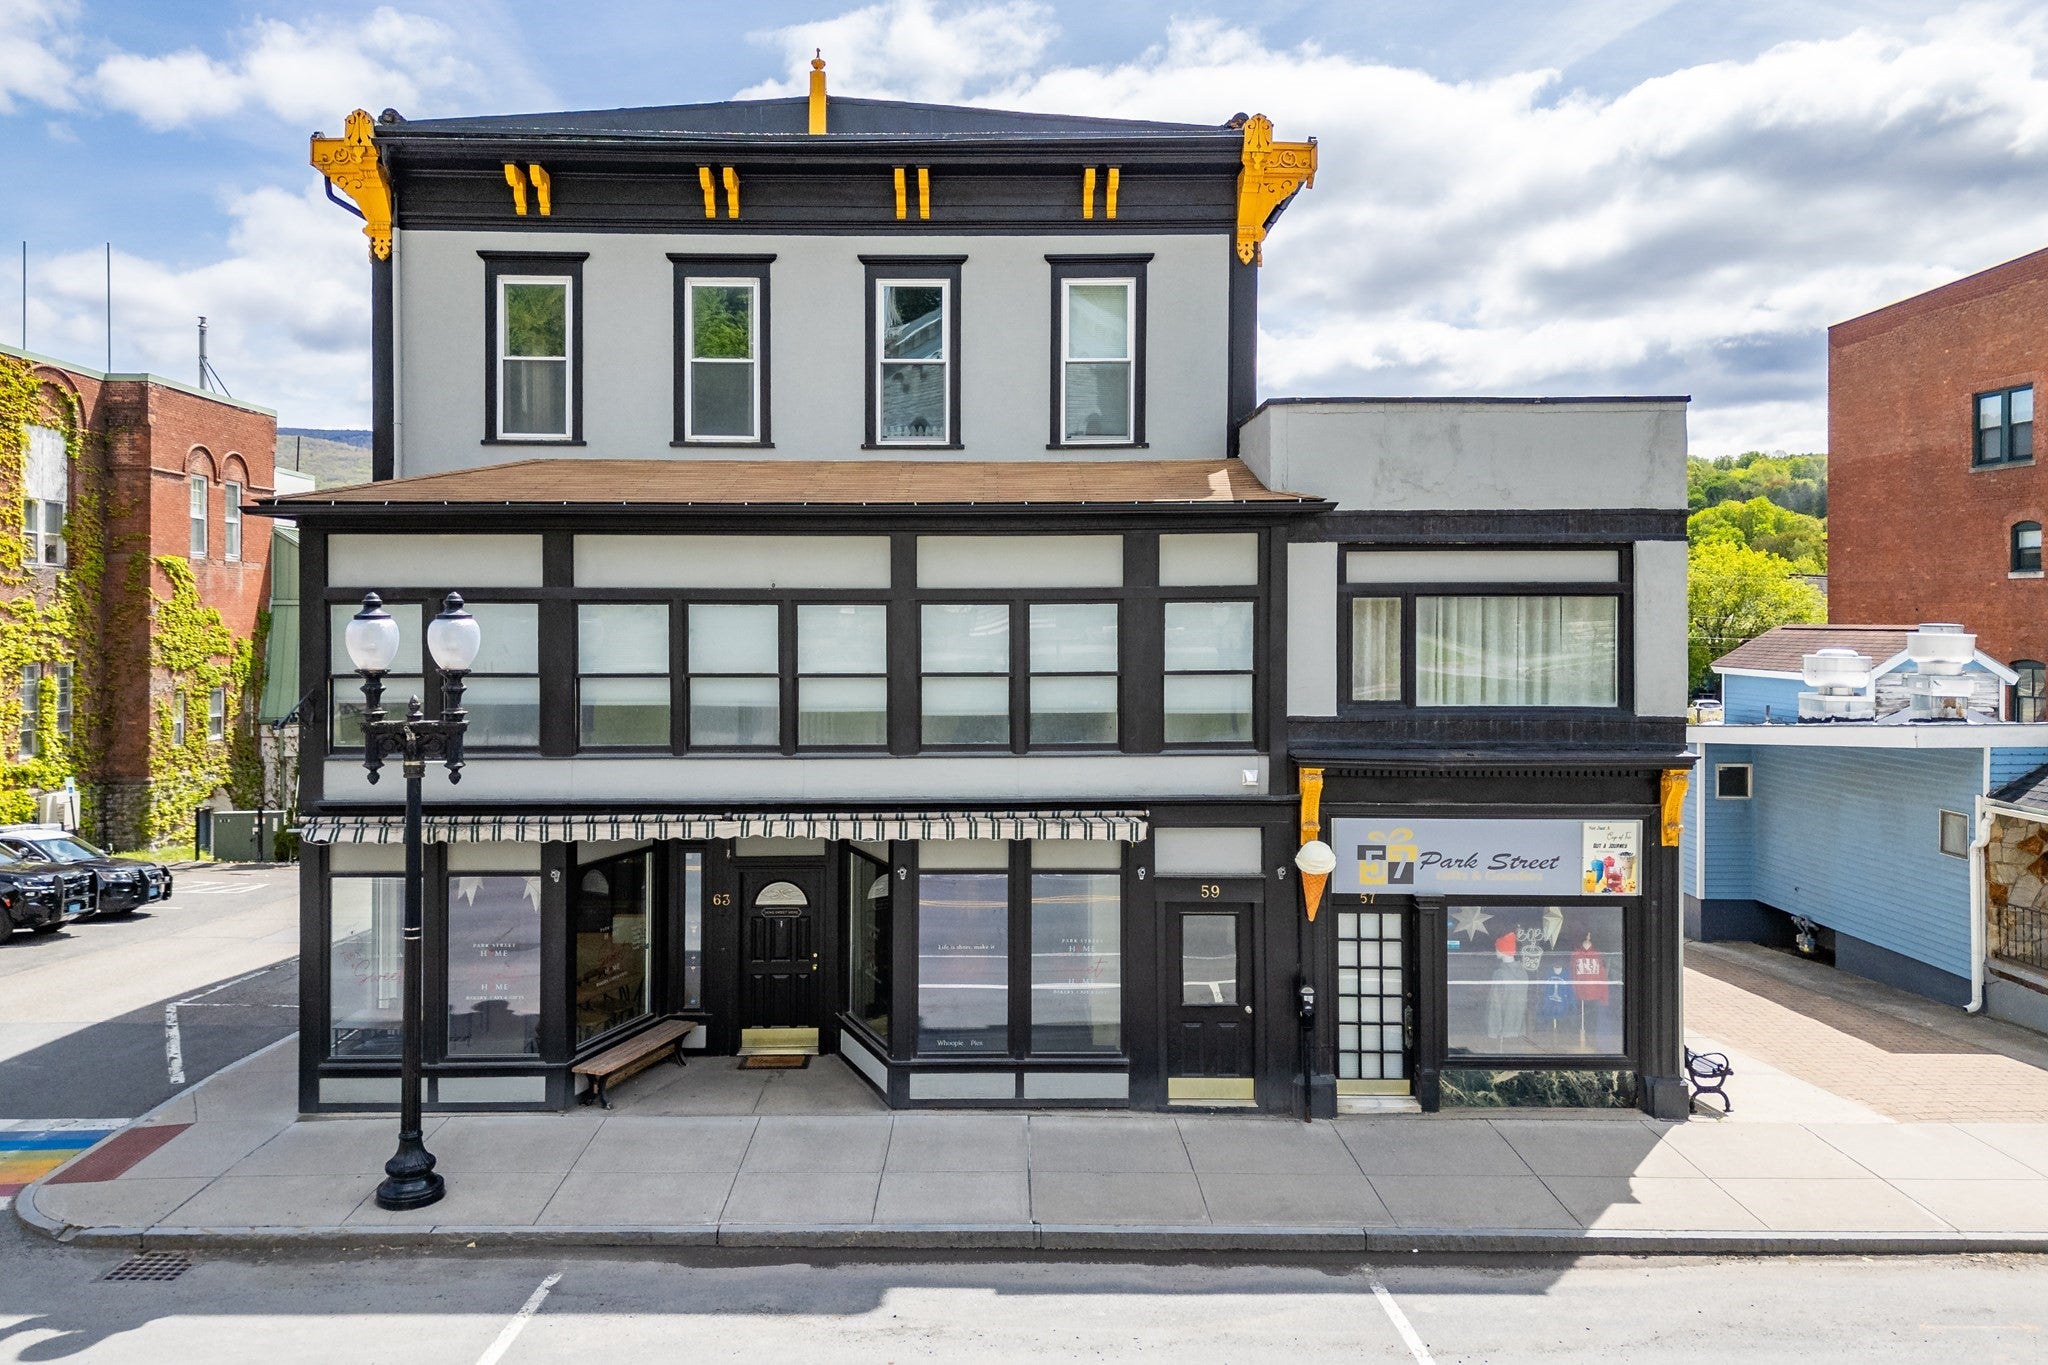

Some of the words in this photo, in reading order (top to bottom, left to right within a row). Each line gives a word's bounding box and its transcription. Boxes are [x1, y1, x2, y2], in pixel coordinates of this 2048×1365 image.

[1419, 851, 1478, 870] Park
[1487, 853, 1560, 870] Street
[1201, 885, 1220, 899] 59
[1360, 893, 1375, 904] 57
[713, 893, 731, 906] 63
[936, 1039, 963, 1048] Whoopie
